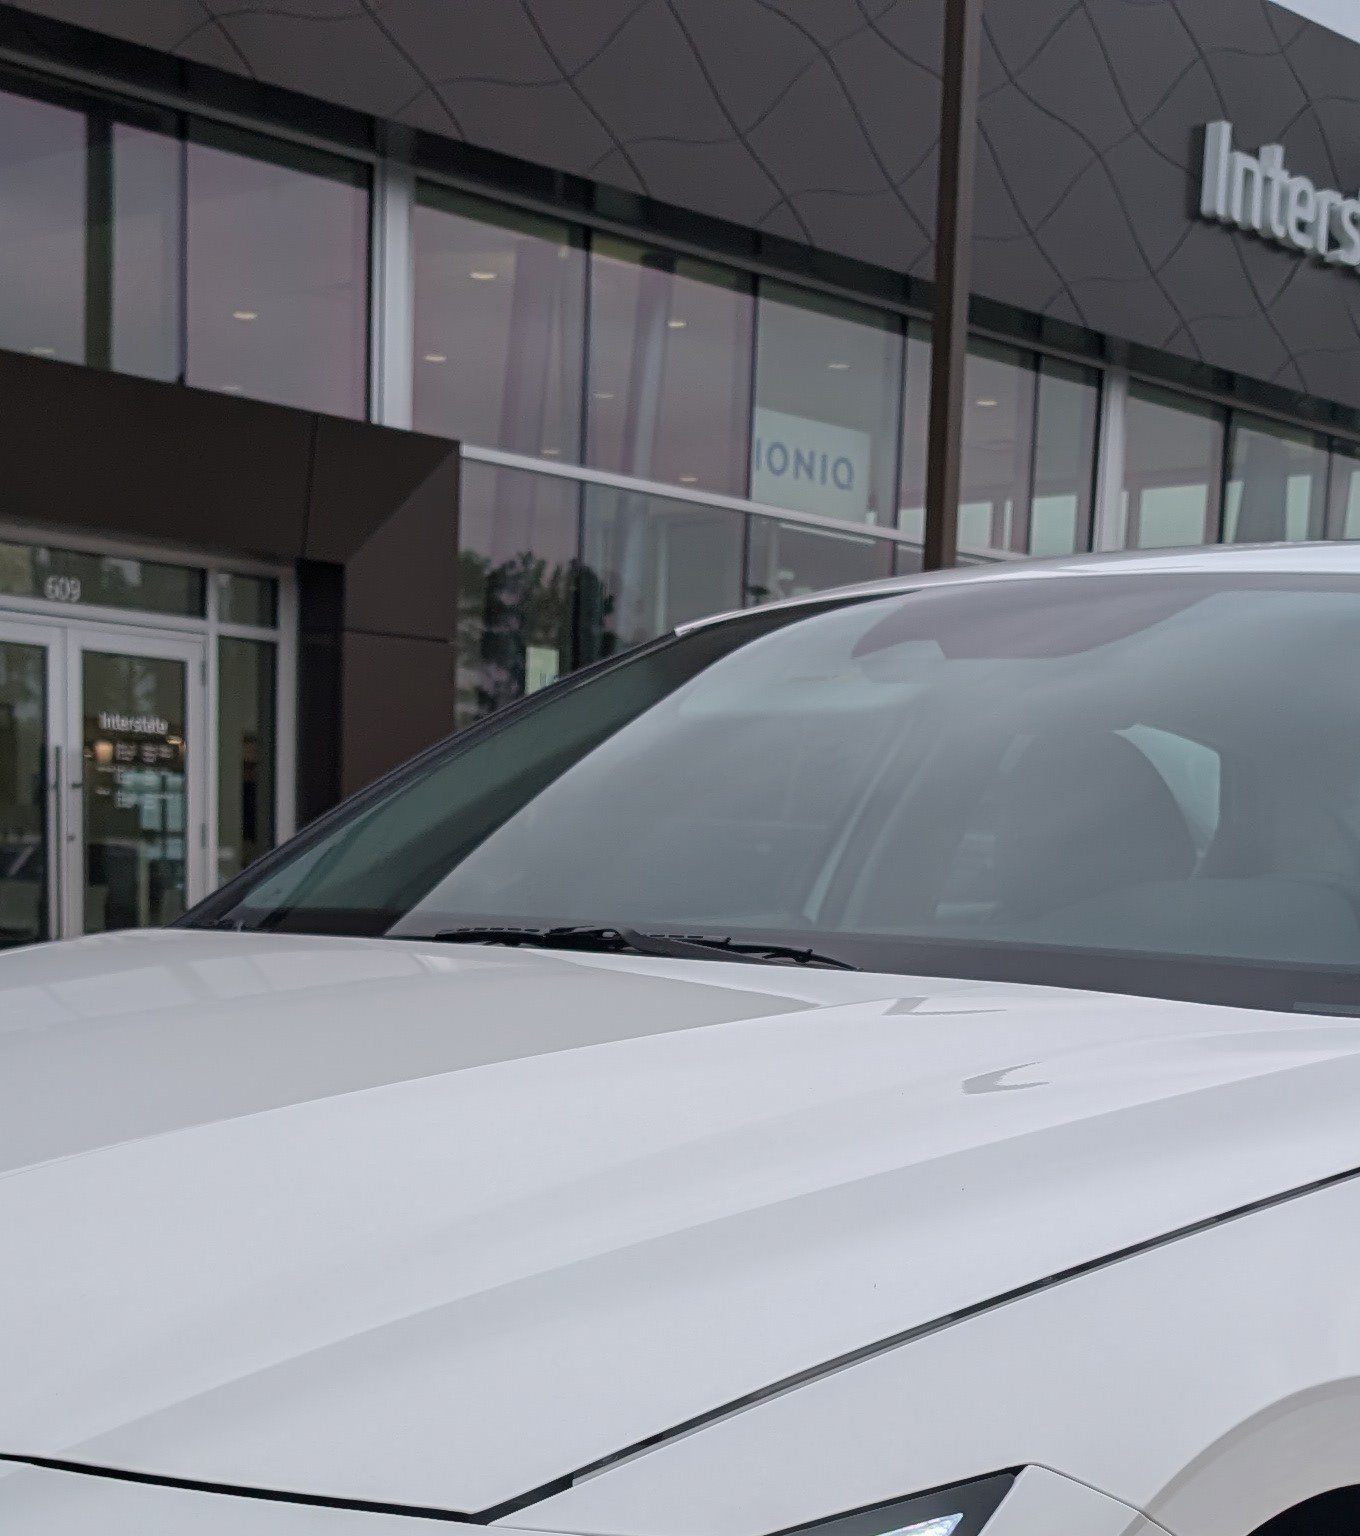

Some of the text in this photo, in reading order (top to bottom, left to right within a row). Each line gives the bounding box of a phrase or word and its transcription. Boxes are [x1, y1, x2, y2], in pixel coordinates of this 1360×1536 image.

[755, 438, 854, 490] IONIQ
[45, 576, 81, 602] 609
[99, 712, 167, 734] Interstate
